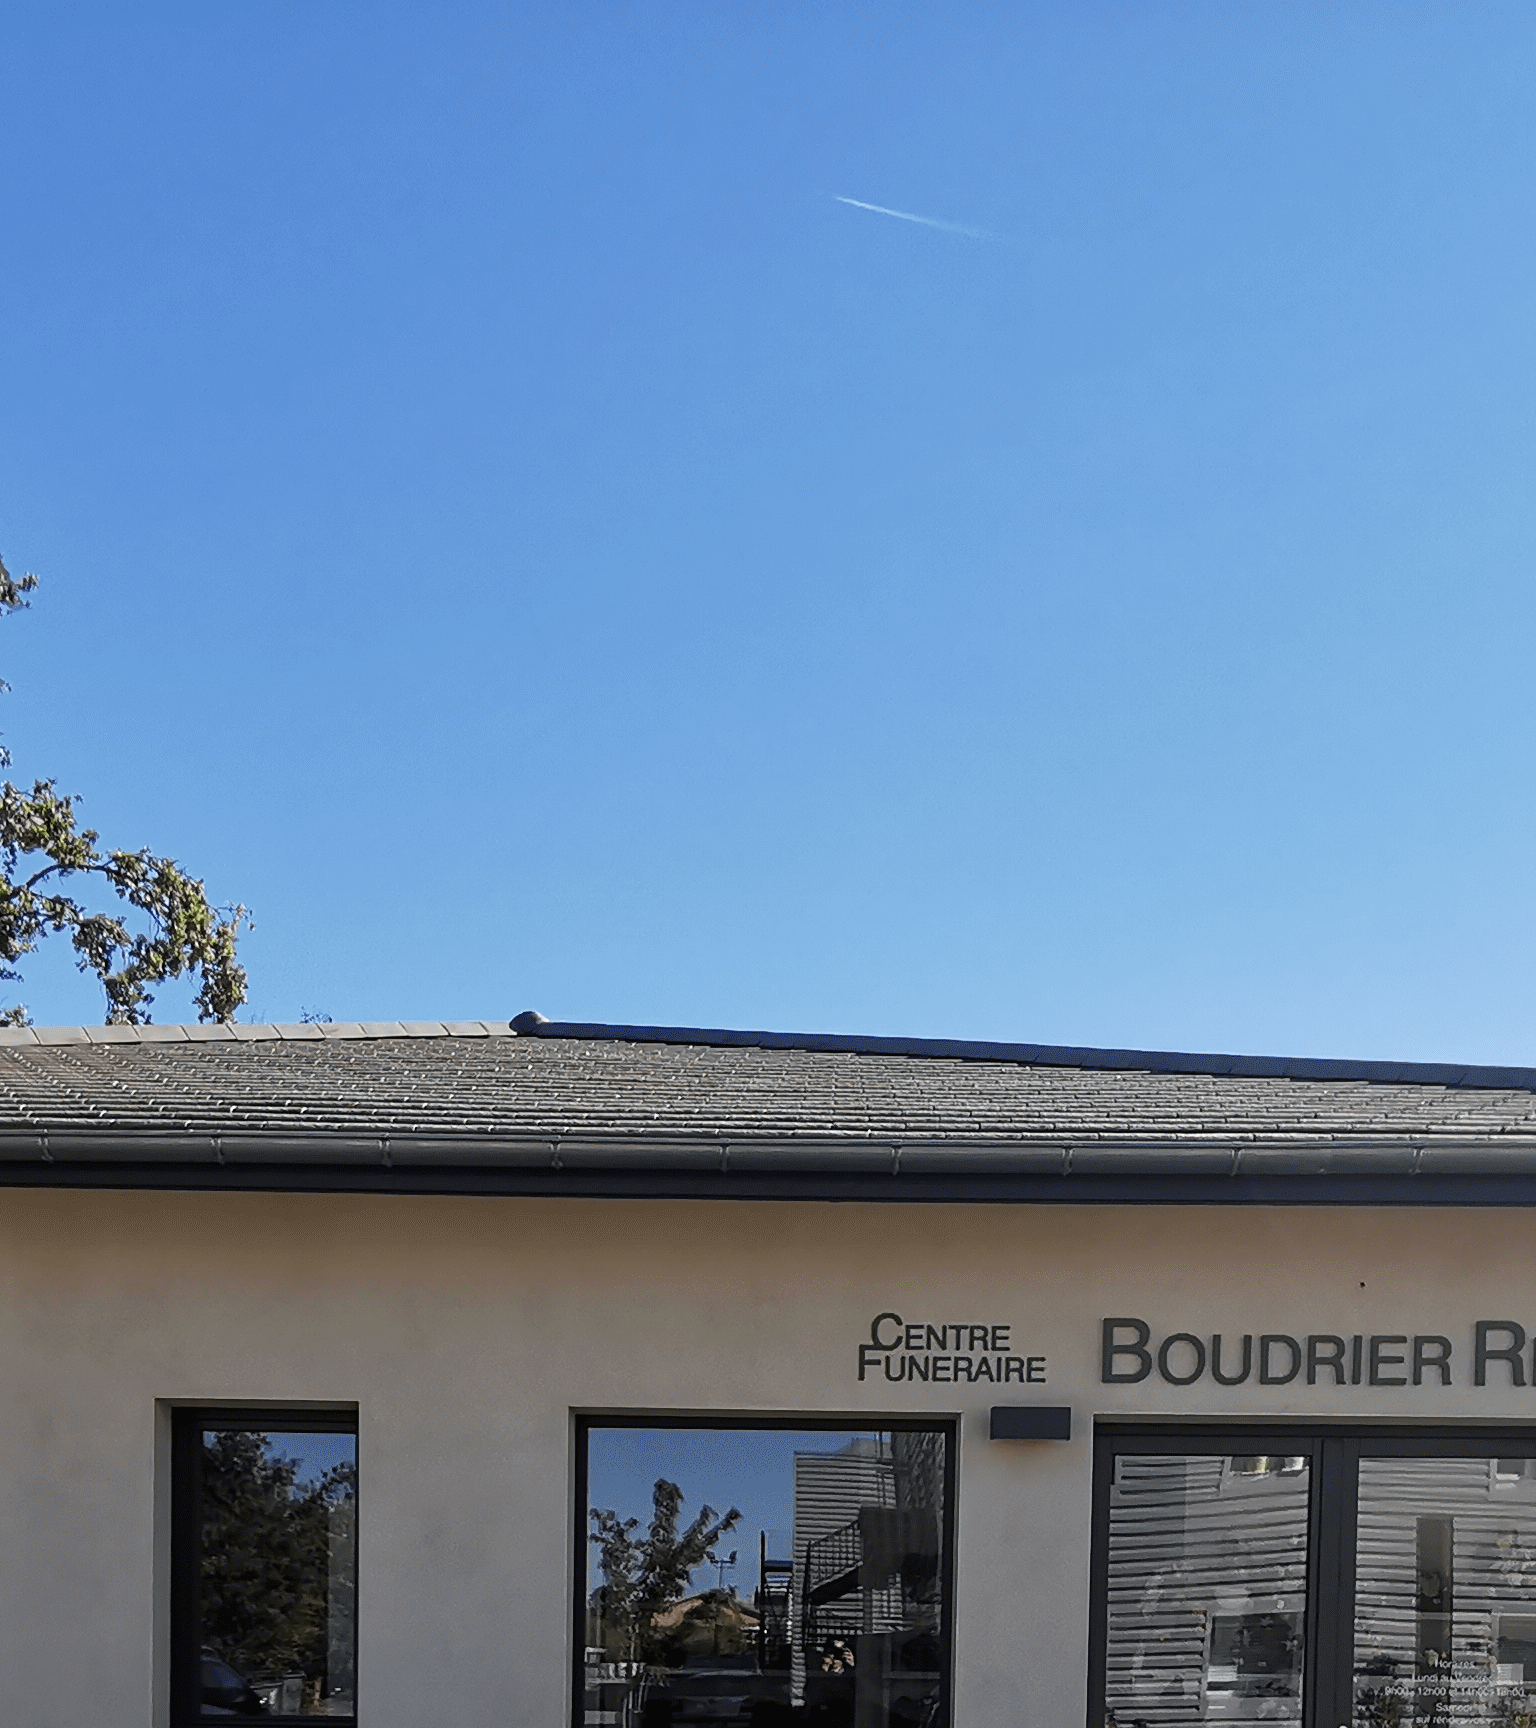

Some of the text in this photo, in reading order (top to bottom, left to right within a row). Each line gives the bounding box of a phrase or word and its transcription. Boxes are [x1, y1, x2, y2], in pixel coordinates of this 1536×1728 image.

[871, 1312, 1010, 1351] CENTRE
[857, 1344, 1046, 1383] FUNERAIRE
[1100, 1317, 1452, 1386] BOUDRIER
